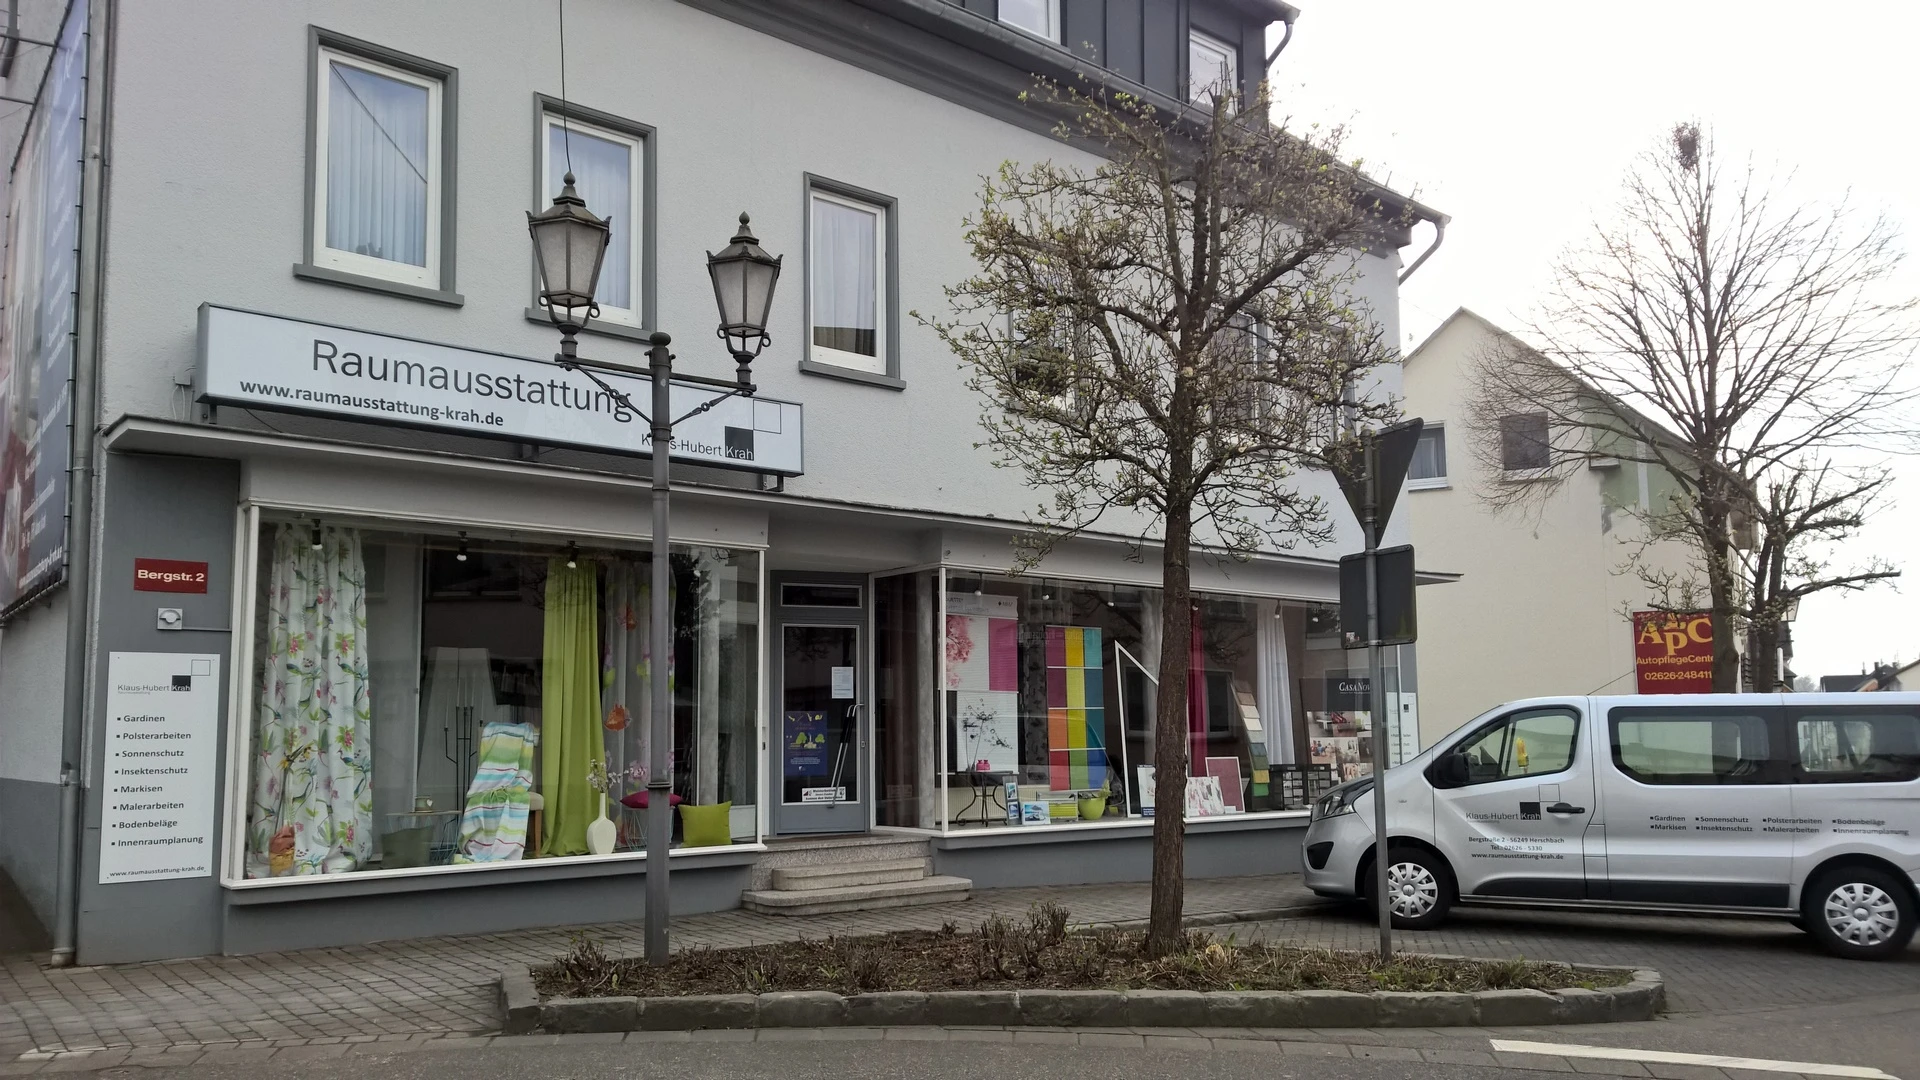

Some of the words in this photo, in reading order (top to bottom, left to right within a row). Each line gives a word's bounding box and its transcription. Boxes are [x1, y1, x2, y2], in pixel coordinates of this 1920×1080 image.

[312, 339, 632, 423] Raumausstattung
[240, 380, 504, 426] www.raumausstattung-krah.de
[641, 433, 722, 458] Ks-Hubert
[726, 445, 754, 460] Krah
[137, 569, 193, 583] Bergstr.
[195, 572, 205, 582] 2
[117, 684, 170, 692] Klaus-Hubert
[123, 715, 165, 723] Gardinen
[122, 732, 192, 740] Polsterarbeiten
[121, 750, 185, 758] Sonnenschutz
[121, 767, 188, 776] Insektenschutz
[120, 785, 163, 794] Markisen
[119, 802, 184, 811] Malerarbeiten
[1465, 812, 1519, 820] Klaus-Hubert
[118, 820, 178, 829] Bodenbeläge
[1837, 818, 1885, 826] Bodenbeläge
[1767, 826, 1820, 834] Malerarbeiten
[118, 837, 204, 847] Innenraumplanung
[1529, 836, 1565, 844] Herschbach
[1471, 853, 1564, 861] www.raumausstattung-krah.de
[109, 866, 205, 877] www.raumausstattung-krah.de
